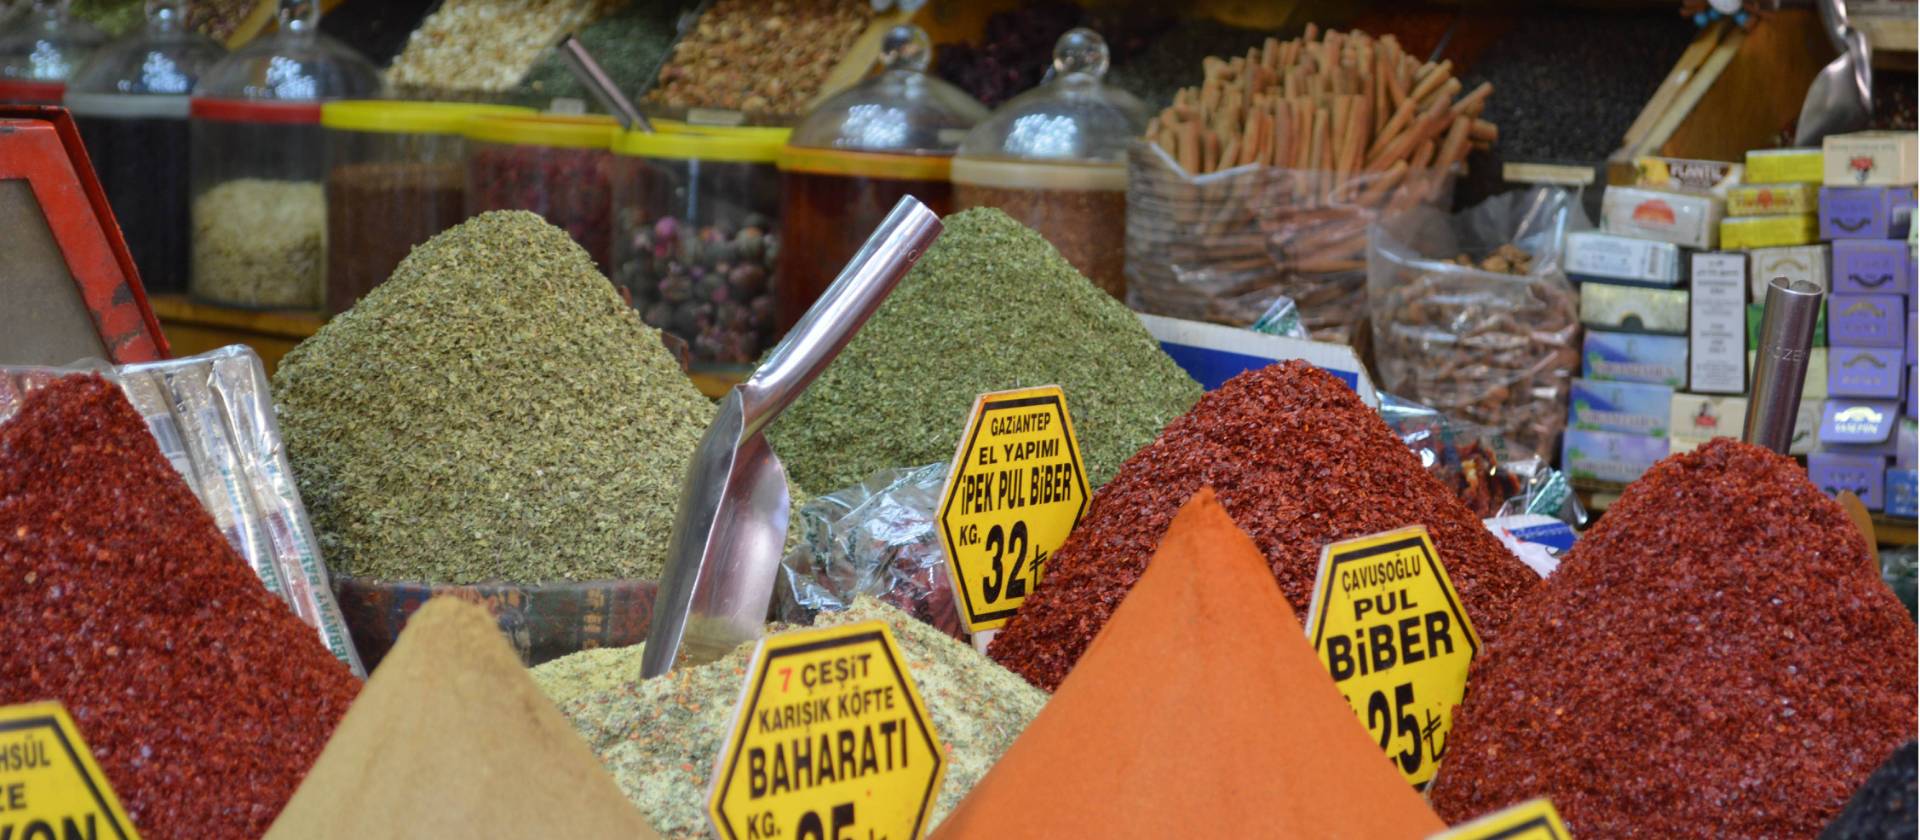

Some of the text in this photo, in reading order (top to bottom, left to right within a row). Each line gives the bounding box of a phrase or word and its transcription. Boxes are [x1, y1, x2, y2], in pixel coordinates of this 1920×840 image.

[979, 438, 1060, 466] EL YAPIMI
[997, 467, 1026, 511] PUL
[959, 523, 981, 546] KG.
[1342, 551, 1422, 599] ÇAVUŞOĞLU
[1353, 588, 1418, 622] PUL
[778, 667, 793, 693] 7
[758, 684, 895, 734] KARIŞIK KÖFTE
[747, 717, 908, 802] BAHARATI
[747, 811, 781, 840] KG.
